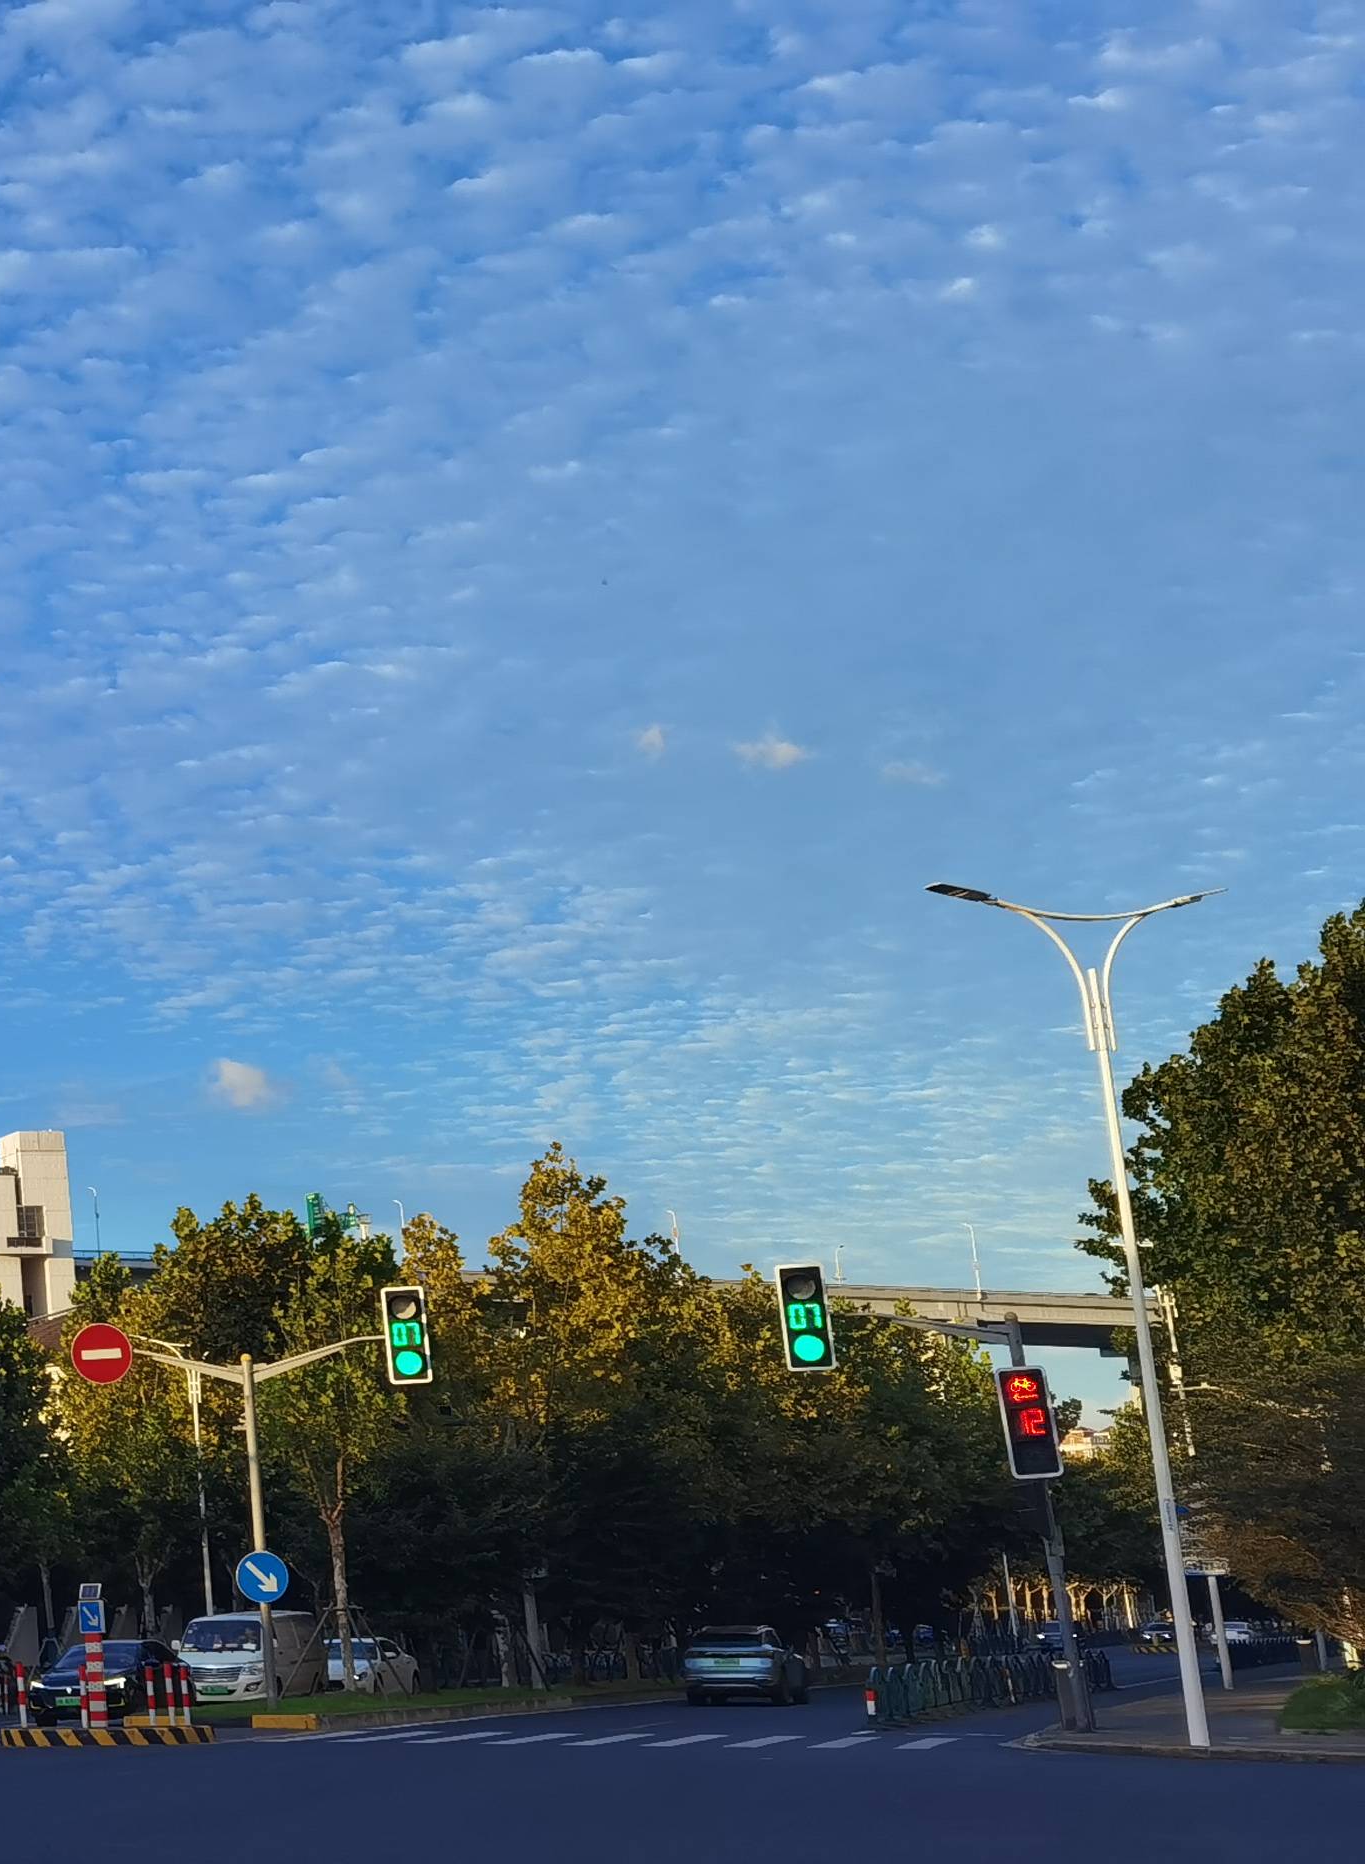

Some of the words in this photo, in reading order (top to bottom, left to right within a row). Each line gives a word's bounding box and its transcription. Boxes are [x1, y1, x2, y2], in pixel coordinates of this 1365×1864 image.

[788, 1303, 823, 1330] 07
[391, 1322, 422, 1348] 07
[1021, 1408, 1046, 1435] 12
